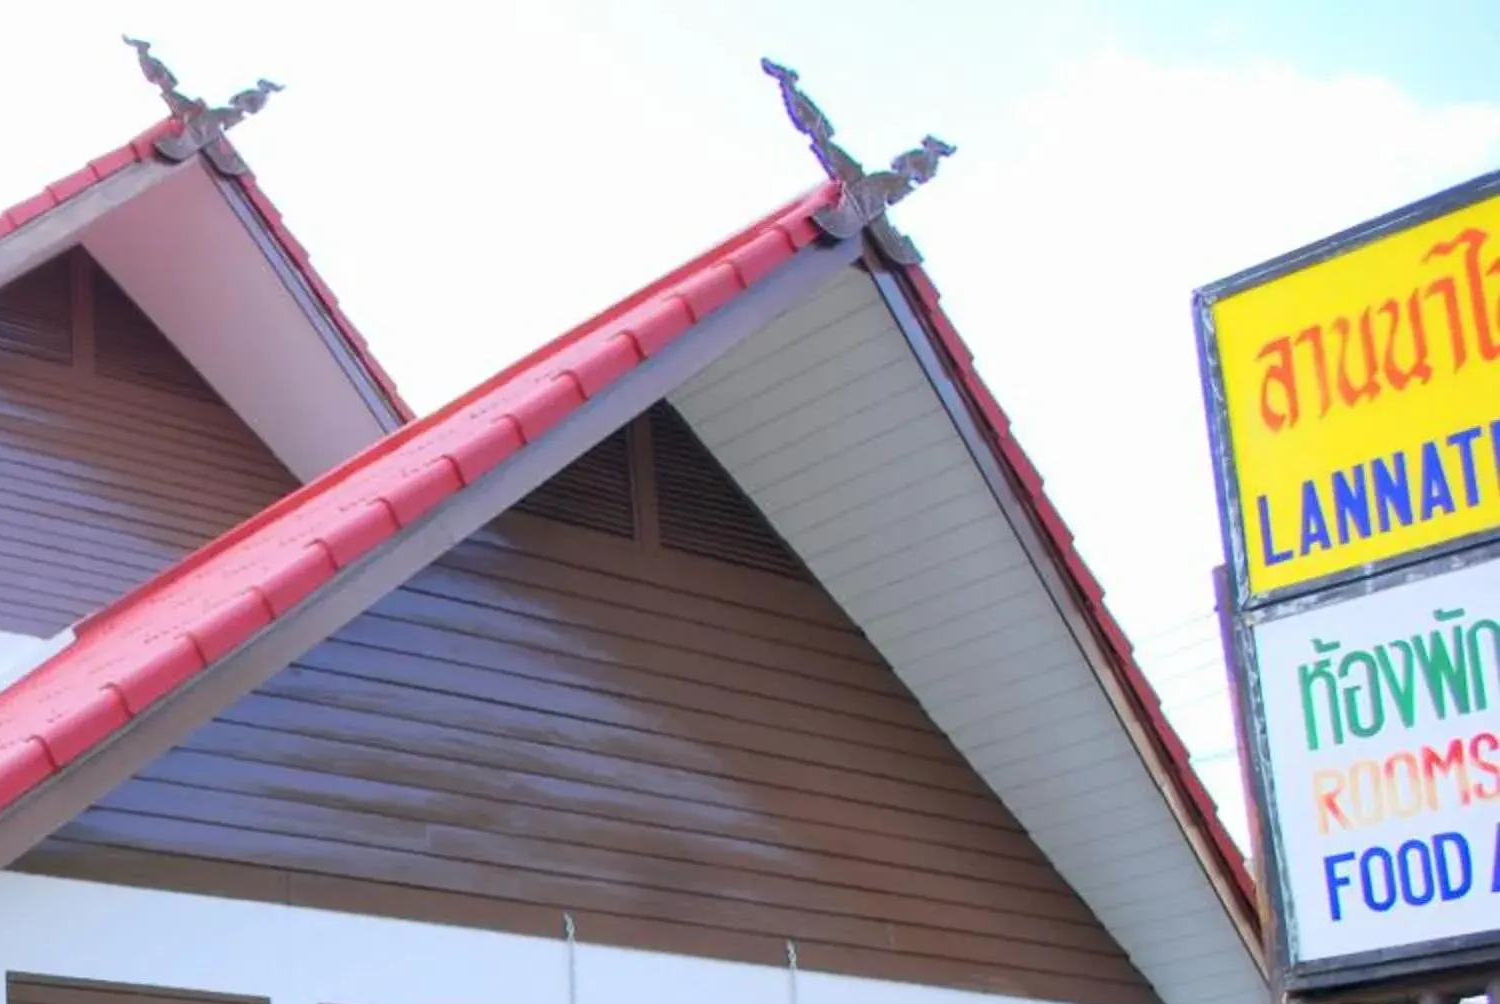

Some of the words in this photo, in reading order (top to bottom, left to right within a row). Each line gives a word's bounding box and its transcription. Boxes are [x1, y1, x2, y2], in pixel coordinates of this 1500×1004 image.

[1254, 227, 1500, 433] ลานนาไ
[1311, 731, 1500, 836] ROOMS
[1323, 831, 1473, 922] FOOD
